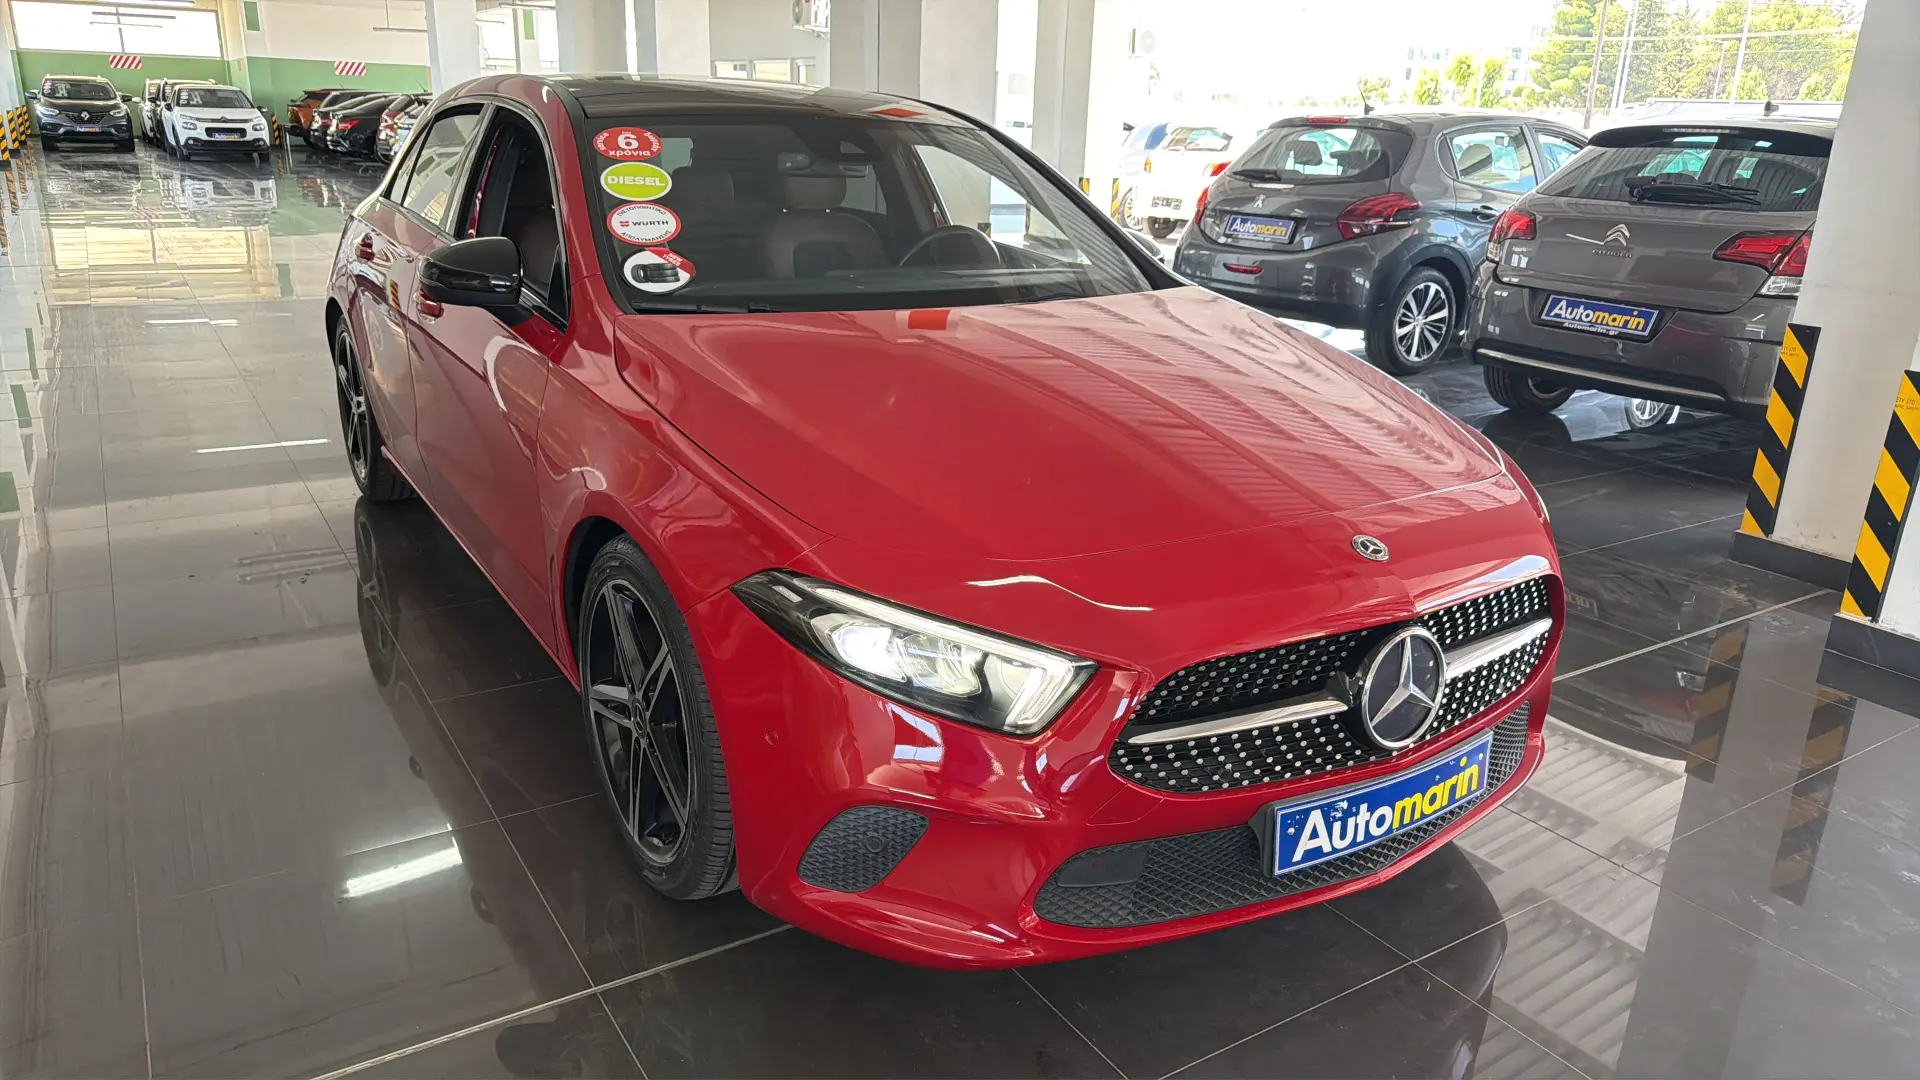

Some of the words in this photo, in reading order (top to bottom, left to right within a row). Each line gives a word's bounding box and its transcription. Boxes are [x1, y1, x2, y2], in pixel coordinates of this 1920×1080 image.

[618, 134, 639, 149] 6
[608, 176, 665, 186] DIESEL
[1230, 217, 1287, 236] Automarin
[1549, 299, 1646, 331] Automarin
[1562, 321, 1620, 336] Automarin.gr
[1291, 755, 1479, 863] Automarin
